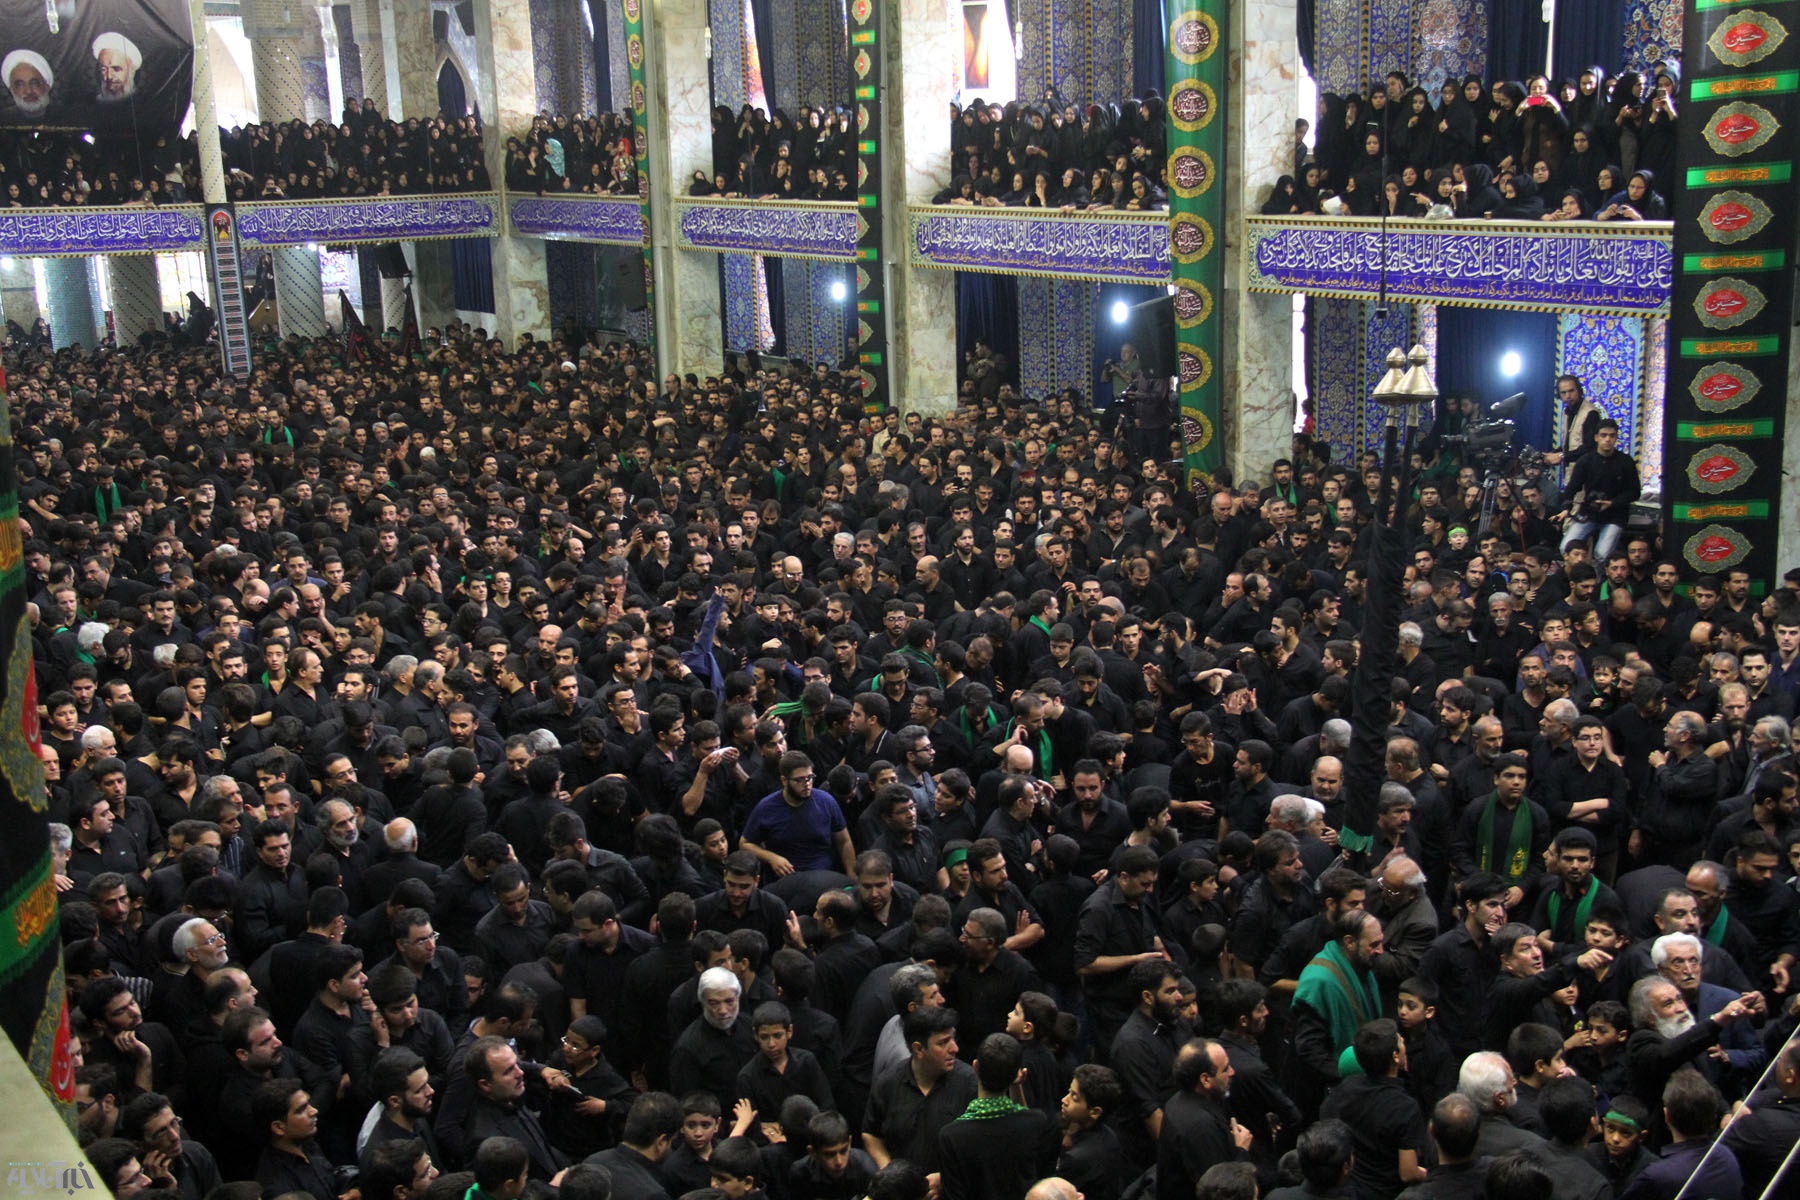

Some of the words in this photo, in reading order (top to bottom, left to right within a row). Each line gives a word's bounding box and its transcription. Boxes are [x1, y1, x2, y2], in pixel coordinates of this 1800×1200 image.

[1725, 33, 1761, 48] حسین
[1719, 123, 1753, 138] حسین
[1712, 212, 1747, 226] حسین
[1706, 298, 1742, 311] حسین
[1703, 383, 1738, 396] حسین
[1701, 465, 1733, 479] حسین
